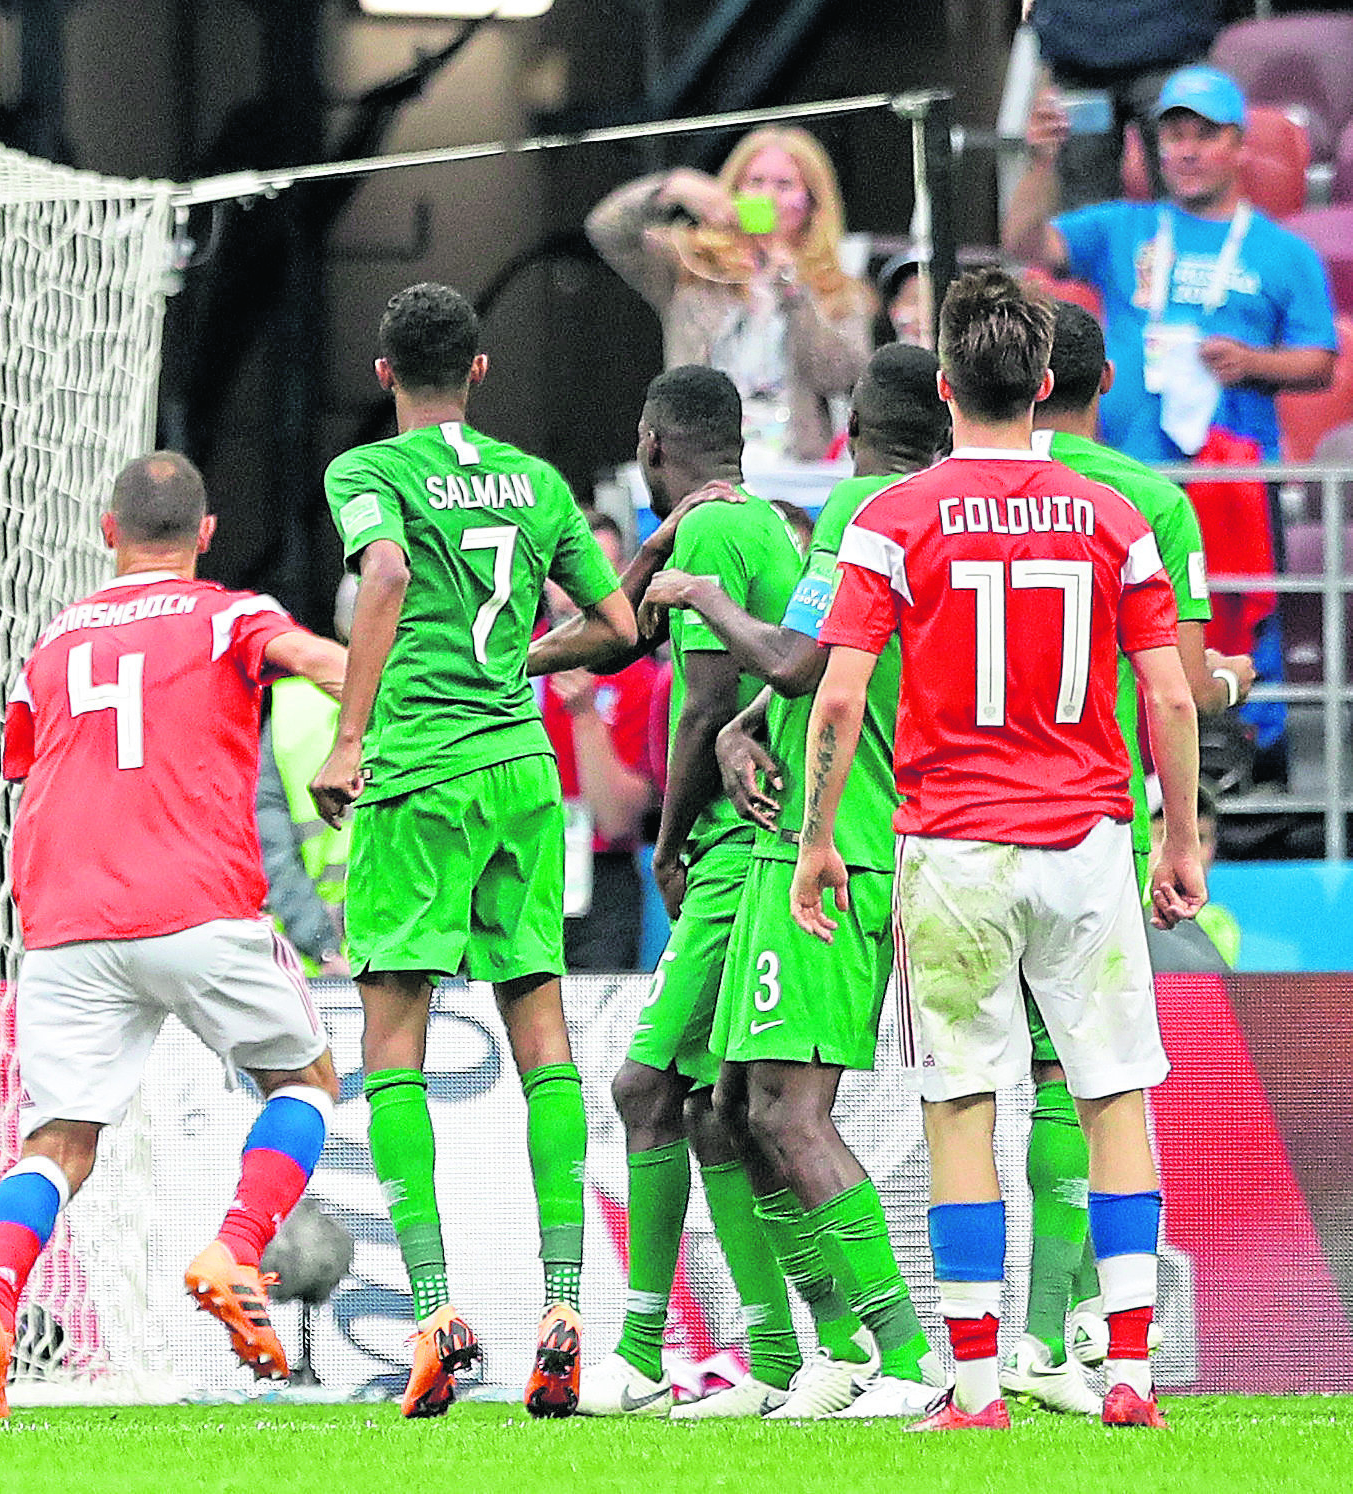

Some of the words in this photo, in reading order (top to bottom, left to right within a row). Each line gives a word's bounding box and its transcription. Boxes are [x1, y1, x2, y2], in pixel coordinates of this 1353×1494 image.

[426, 473, 536, 510] SALMAN
[939, 496, 1095, 536] GOLOVIN
[460, 525, 520, 665] 7
[950, 560, 1093, 727] 17
[67, 641, 146, 771] 4
[754, 950, 780, 1012] 3
